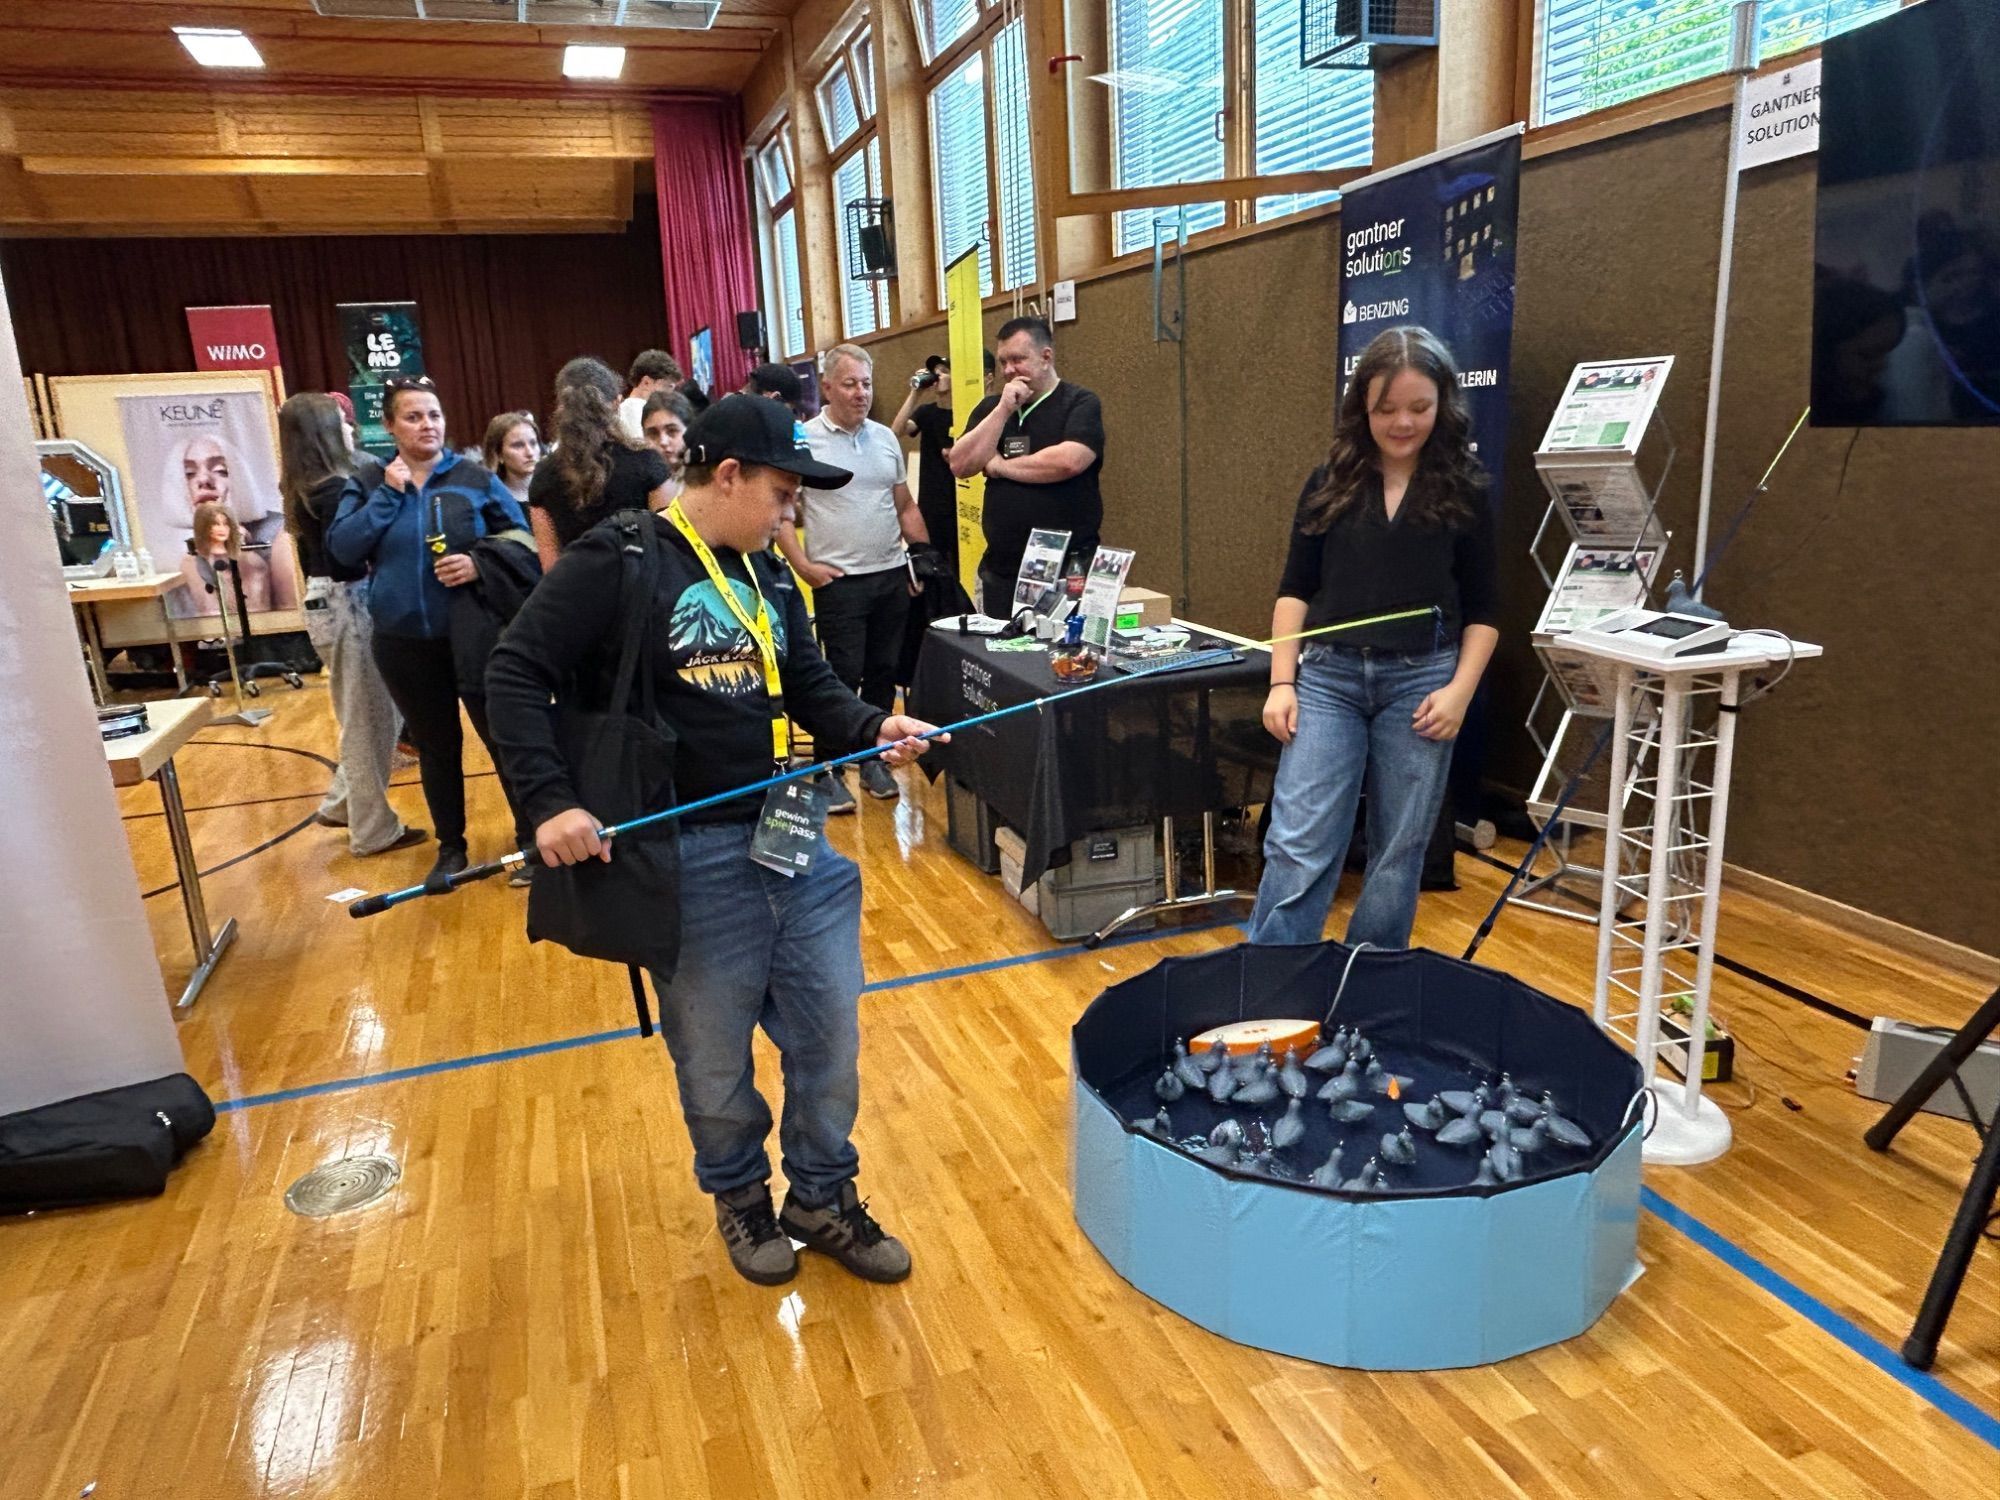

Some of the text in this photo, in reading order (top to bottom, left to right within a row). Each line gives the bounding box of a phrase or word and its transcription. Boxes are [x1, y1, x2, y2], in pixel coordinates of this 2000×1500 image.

[1751, 85, 1821, 119] GANTNER
[1347, 218, 1405, 256] gantner
[1346, 246, 1412, 278] solutions
[1359, 298, 1409, 322] BENZING
[367, 333, 396, 351] LE
[206, 343, 266, 361] WIMO
[160, 402, 222, 421] KEUNE
[685, 654, 719, 667] JACK
[775, 808, 810, 825] gewinn
